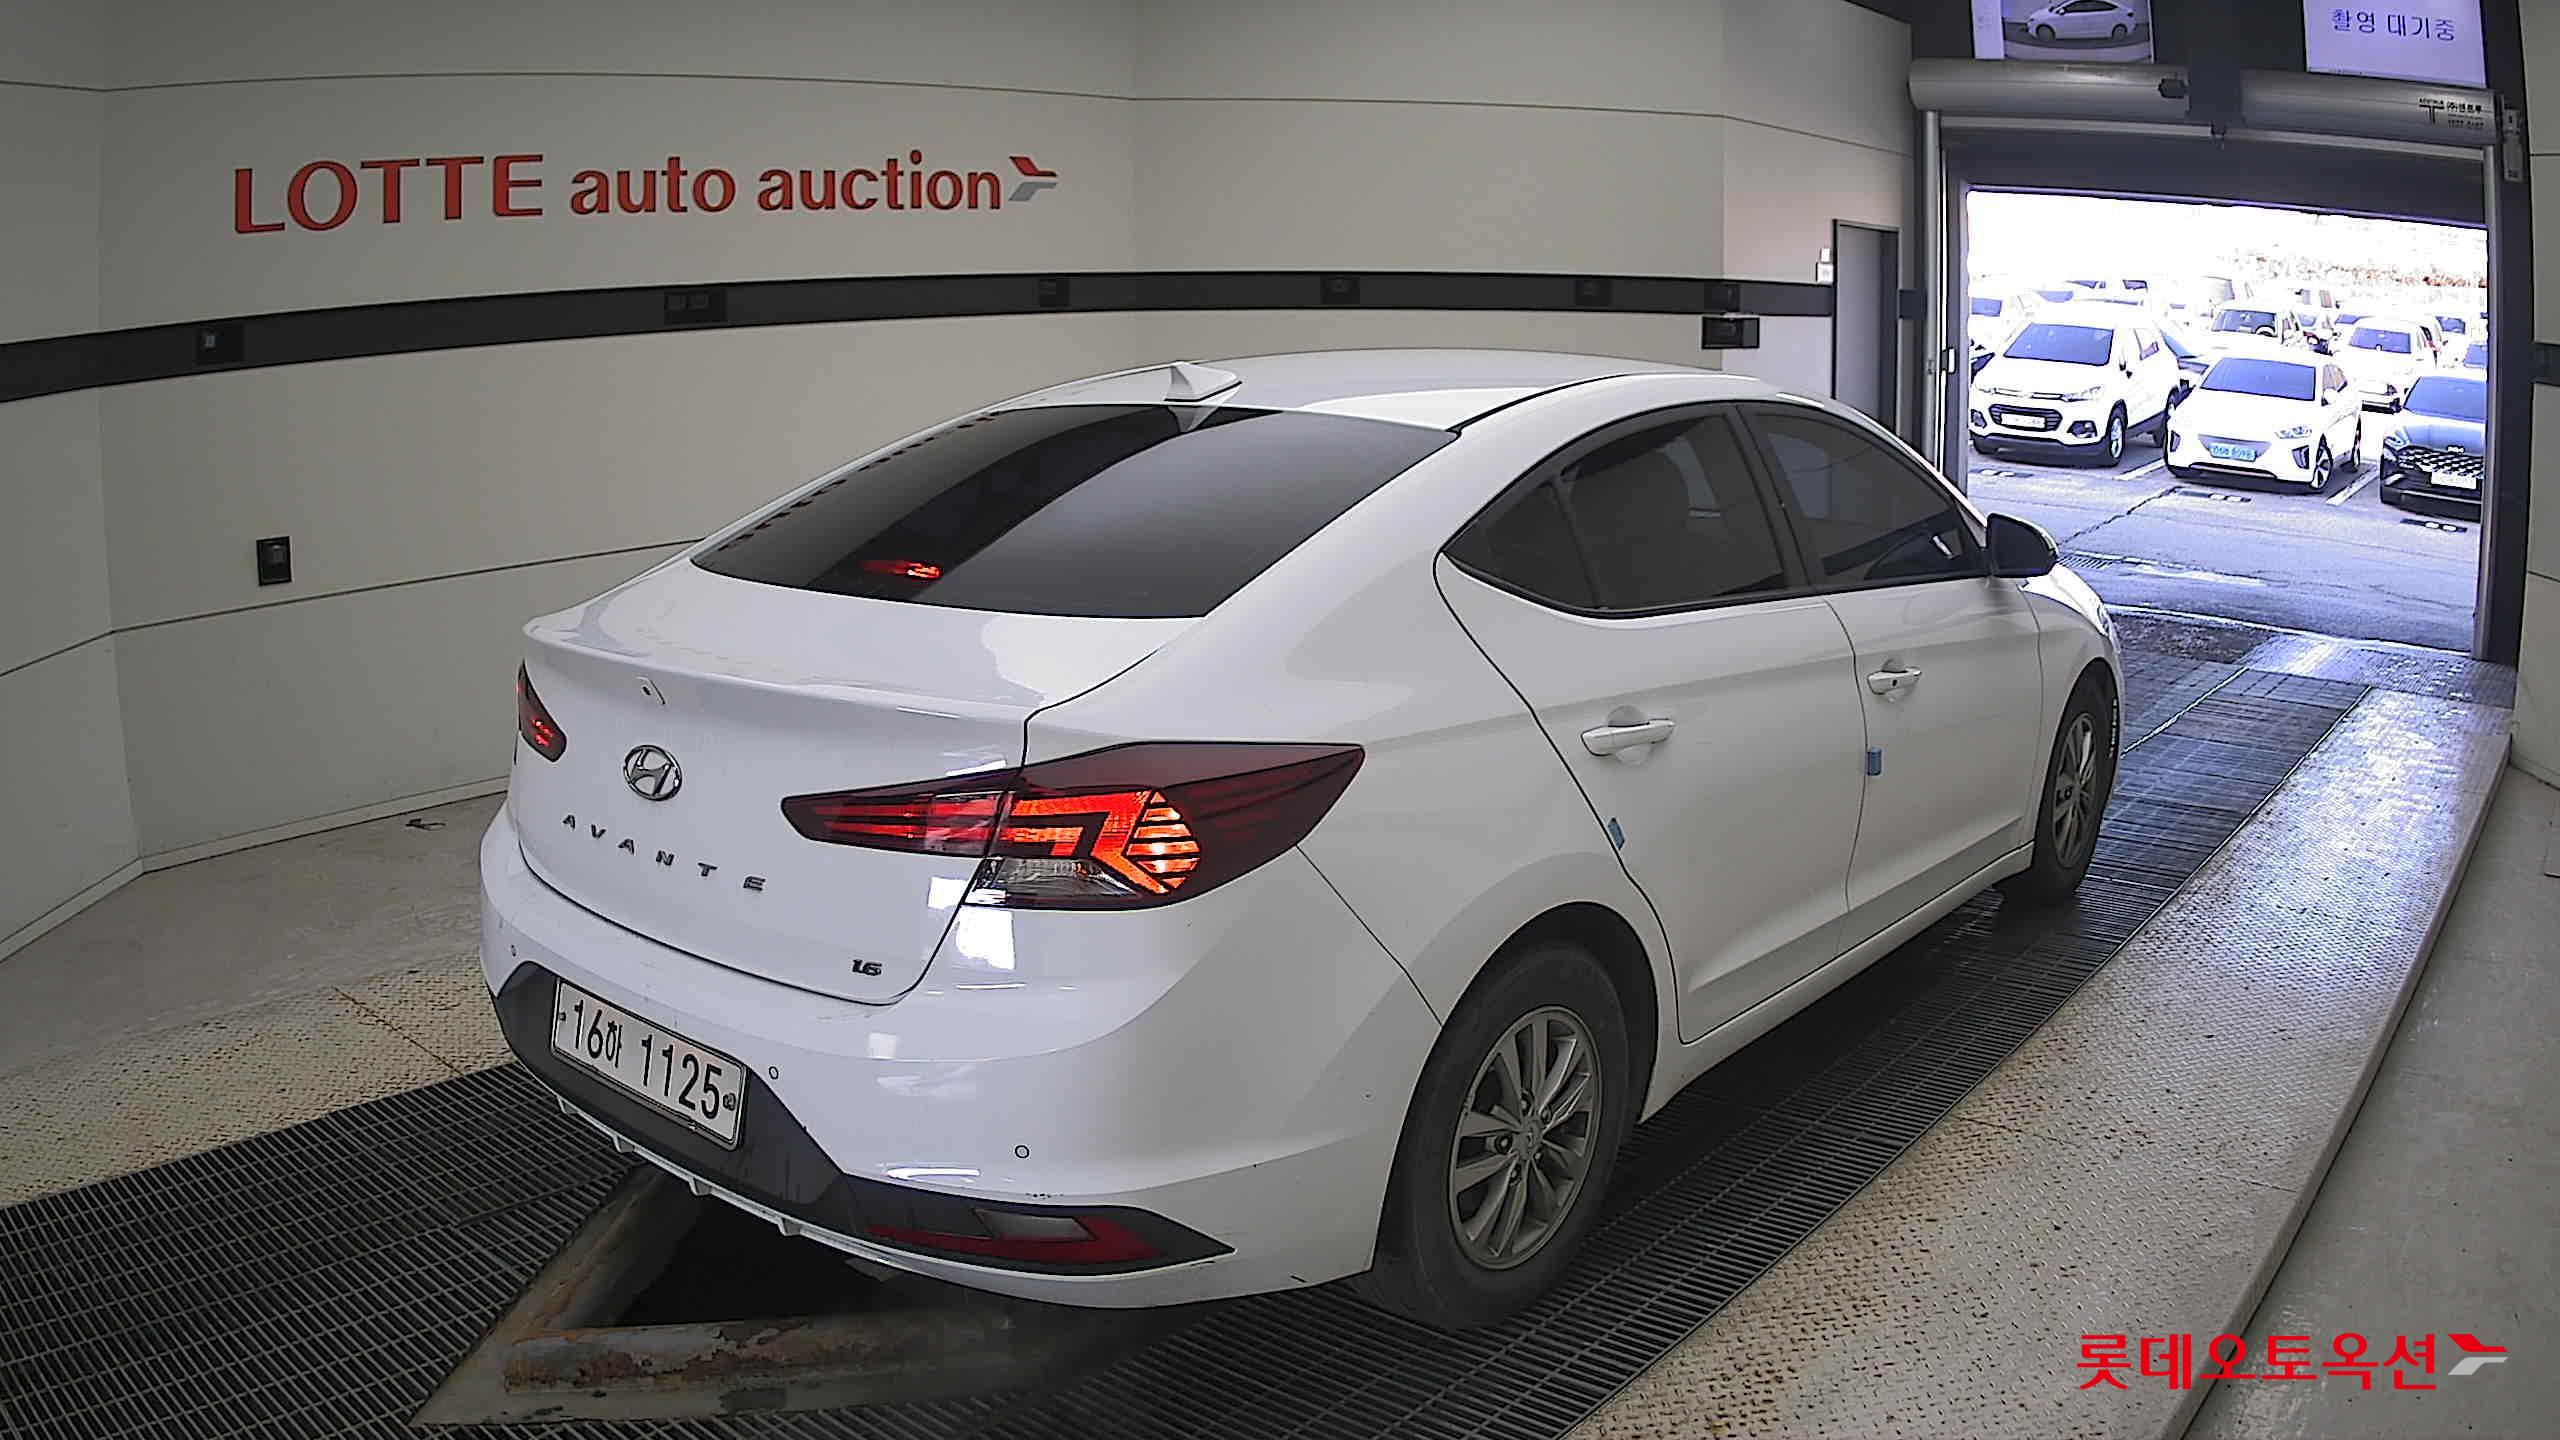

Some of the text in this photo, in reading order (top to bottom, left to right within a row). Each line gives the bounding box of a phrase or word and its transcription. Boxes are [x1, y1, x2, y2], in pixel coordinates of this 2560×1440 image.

[2332, 8, 2455, 41] 촬영 대기중
[234, 151, 1003, 234] LOTTE auto auction
[563, 814, 766, 892] AVANTE
[574, 999, 722, 1120] 16하 1125
